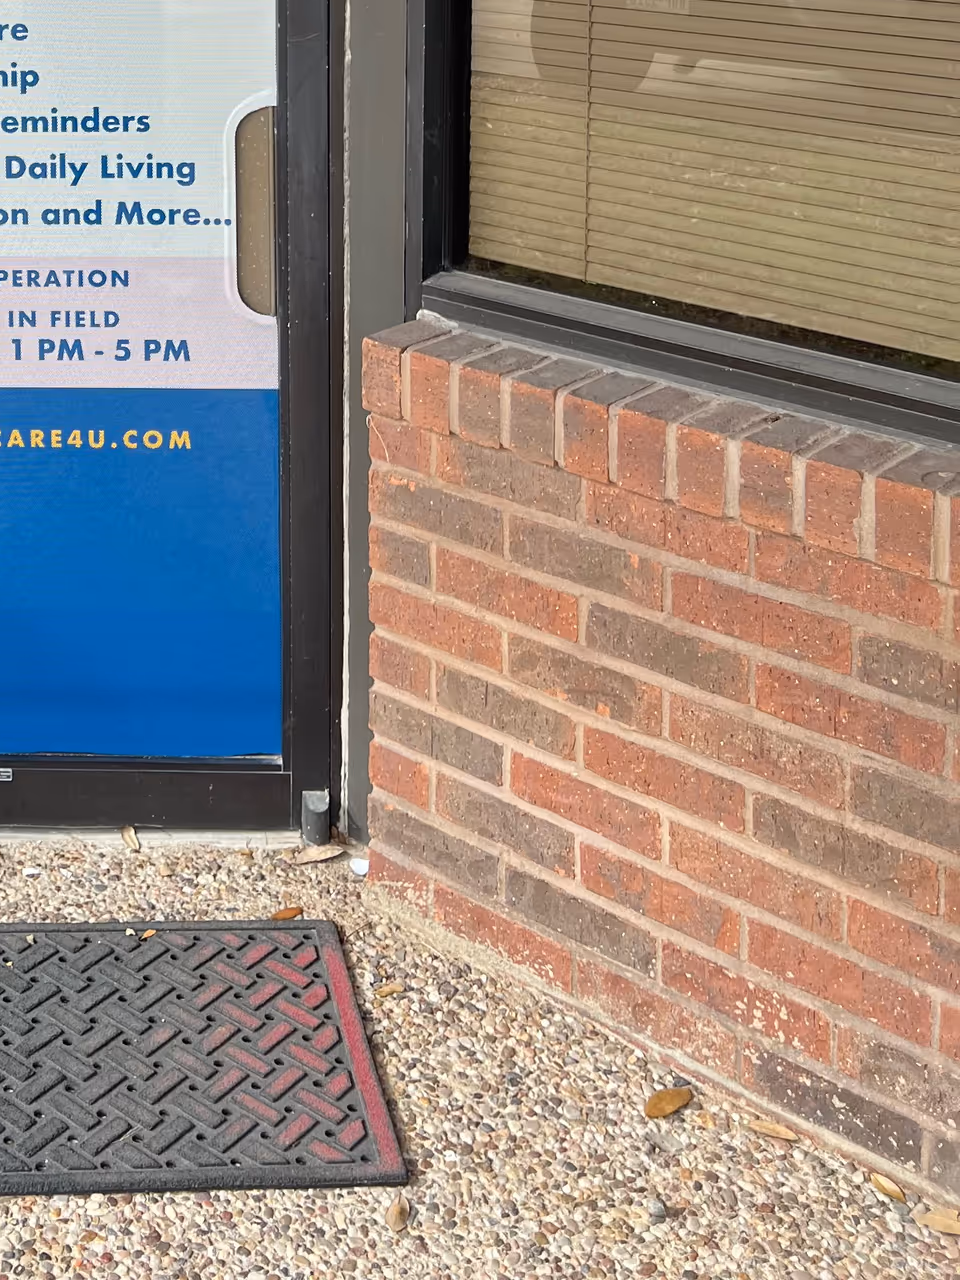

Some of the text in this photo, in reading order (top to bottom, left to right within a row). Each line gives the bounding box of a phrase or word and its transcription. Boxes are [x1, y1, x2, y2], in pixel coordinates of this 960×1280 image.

[5, 152, 89, 187] Daily
[100, 152, 196, 187] Living
[41, 199, 103, 226] and
[114, 200, 233, 227] More...
[8, 310, 120, 328] IN FIELD
[11, 338, 22, 361] 1
[38, 338, 85, 361] PM
[114, 339, 131, 362] 5
[144, 339, 191, 362] PM
